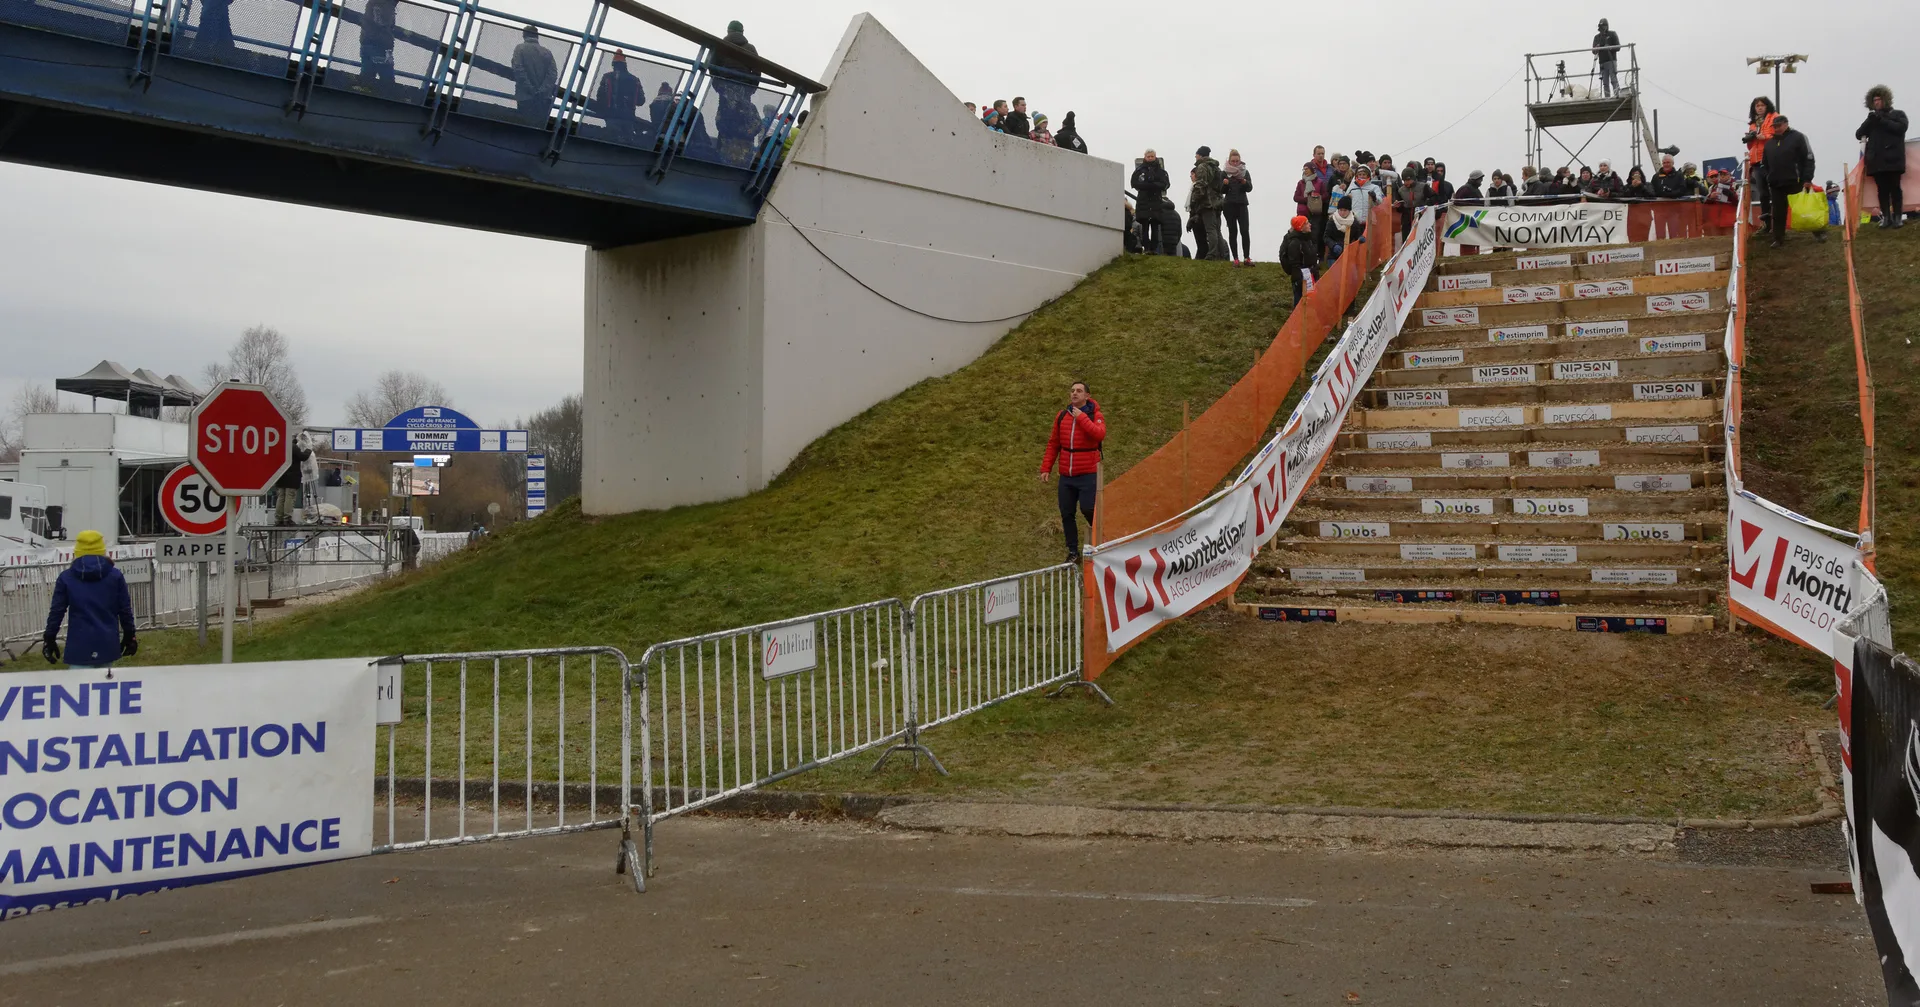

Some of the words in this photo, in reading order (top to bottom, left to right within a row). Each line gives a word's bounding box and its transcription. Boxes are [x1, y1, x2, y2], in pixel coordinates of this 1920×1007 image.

[1498, 209, 1588, 223] COMMUNE
[1603, 209, 1623, 221] DE
[1495, 225, 1615, 244] NOMMAY
[1681, 298, 1705, 306] MACCHI
[1506, 331, 1544, 339] estimprim
[1584, 326, 1625, 335] estimprim
[1659, 340, 1701, 349] estimprim
[1421, 355, 1460, 364] estimprim
[1479, 367, 1528, 376] NIPSON
[1560, 362, 1611, 372] NIPSON
[1641, 384, 1695, 394] NIPSON
[1393, 392, 1442, 400] NIPSON
[205, 423, 280, 455] STOP
[179, 484, 227, 513] 50
[163, 543, 239, 556] RAPPE
[1161, 535, 1185, 556] Pays
[1793, 544, 1824, 570] Pays
[1825, 557, 1844, 579] de
[0, 777, 238, 831] OCATION
